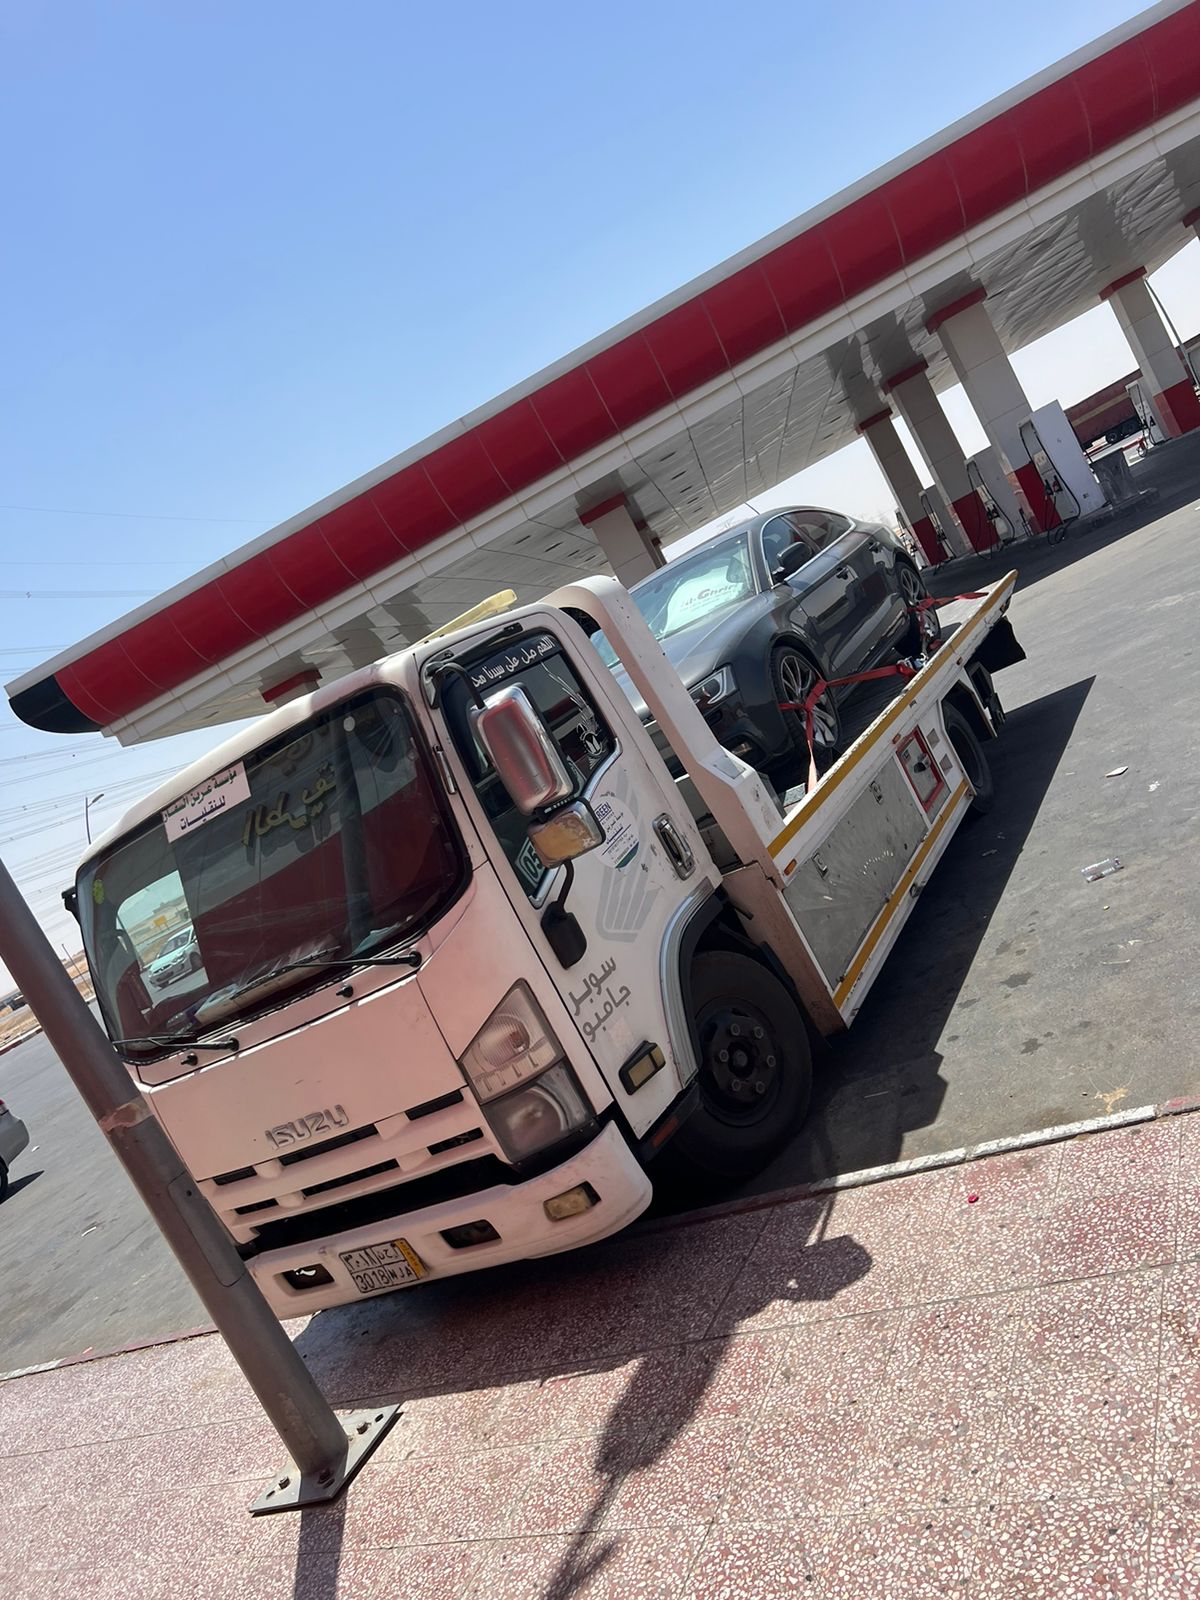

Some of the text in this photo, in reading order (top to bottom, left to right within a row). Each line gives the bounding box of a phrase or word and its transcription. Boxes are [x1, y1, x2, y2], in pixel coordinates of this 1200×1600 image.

[521, 648, 537, 664] صل
[537, 635, 556, 656] اللهم
[213, 769, 237, 789] مؤسسة
[180, 795, 226, 831] للنقليات
[595, 801, 612, 820] REEN
[568, 957, 617, 1017] سوبر
[582, 985, 632, 1043] جامبو
[264, 1104, 350, 1151] ISUZU
[356, 1270, 391, 1291] 3018
